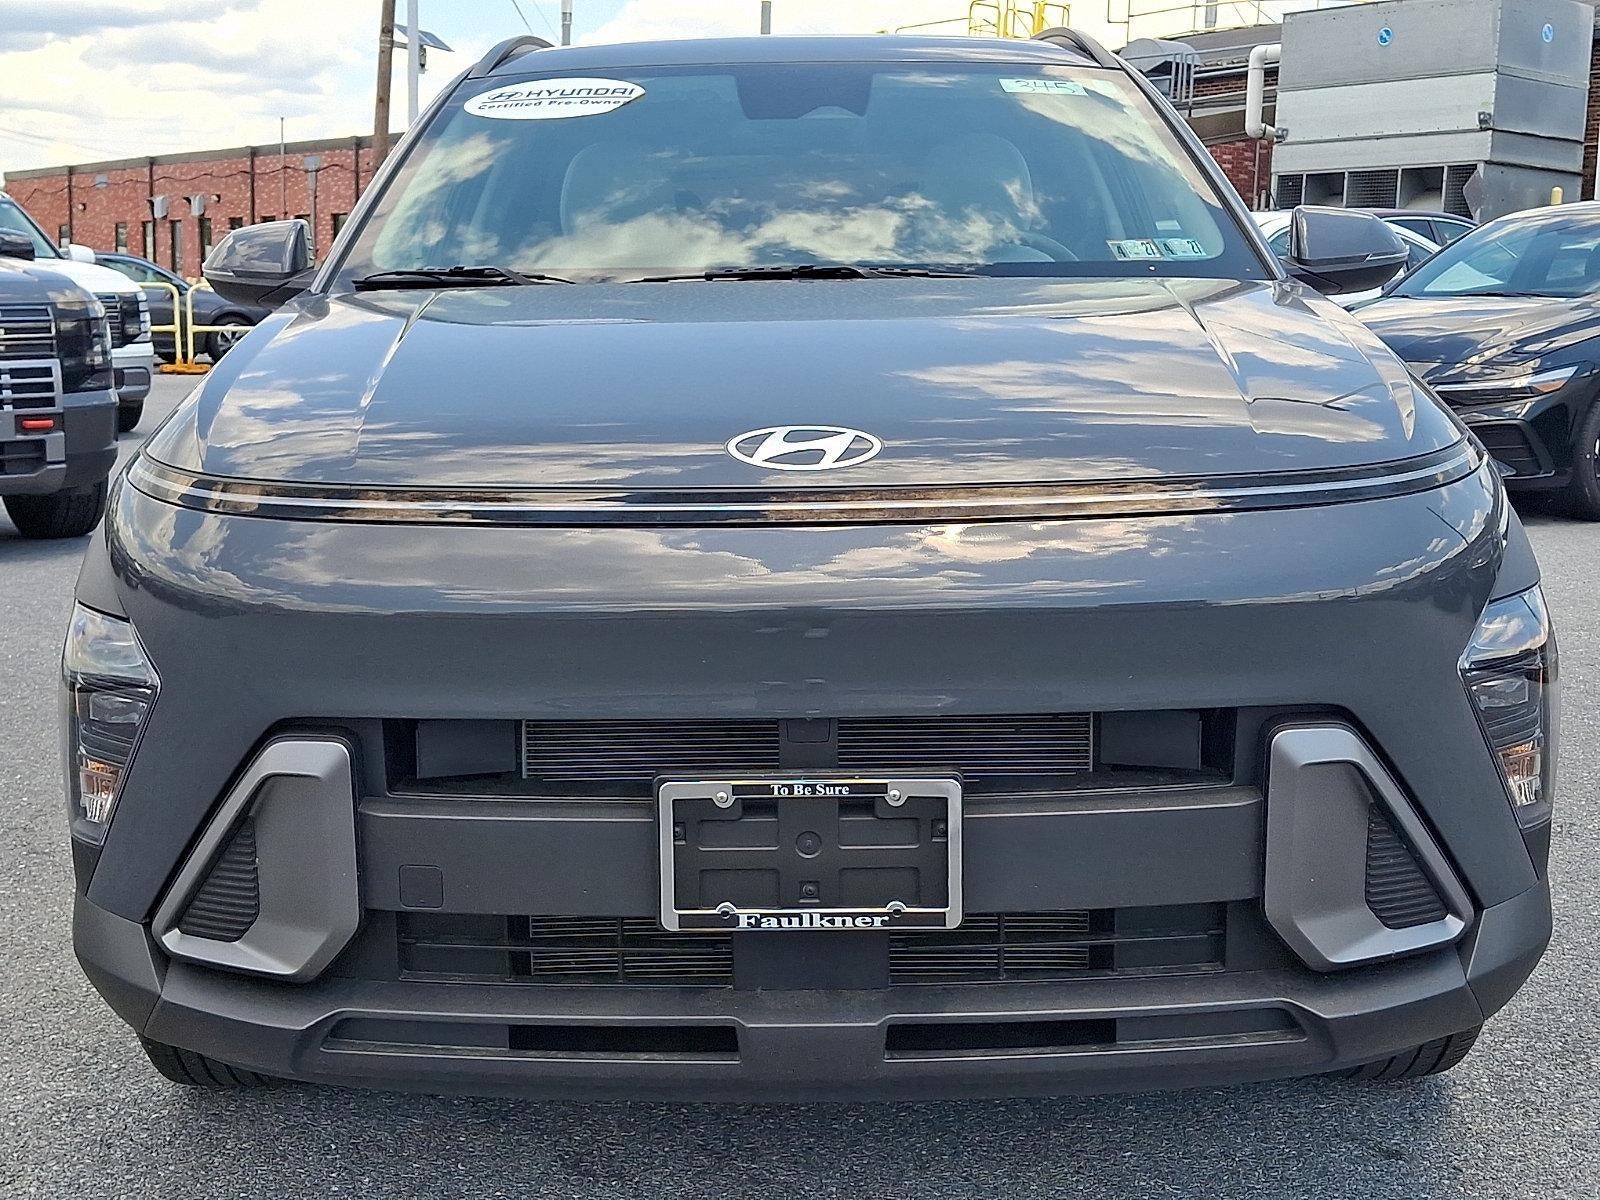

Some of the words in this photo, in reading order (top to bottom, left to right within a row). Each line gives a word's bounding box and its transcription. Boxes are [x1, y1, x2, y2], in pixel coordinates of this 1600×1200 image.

[525, 87, 636, 98] HYUNDAI
[1015, 80, 1076, 93] 345
[477, 101, 543, 111] Certified
[770, 784, 789, 796] To
[793, 784, 813, 796] Be
[815, 783, 850, 796] Sure
[736, 913, 889, 929] Faulkner
